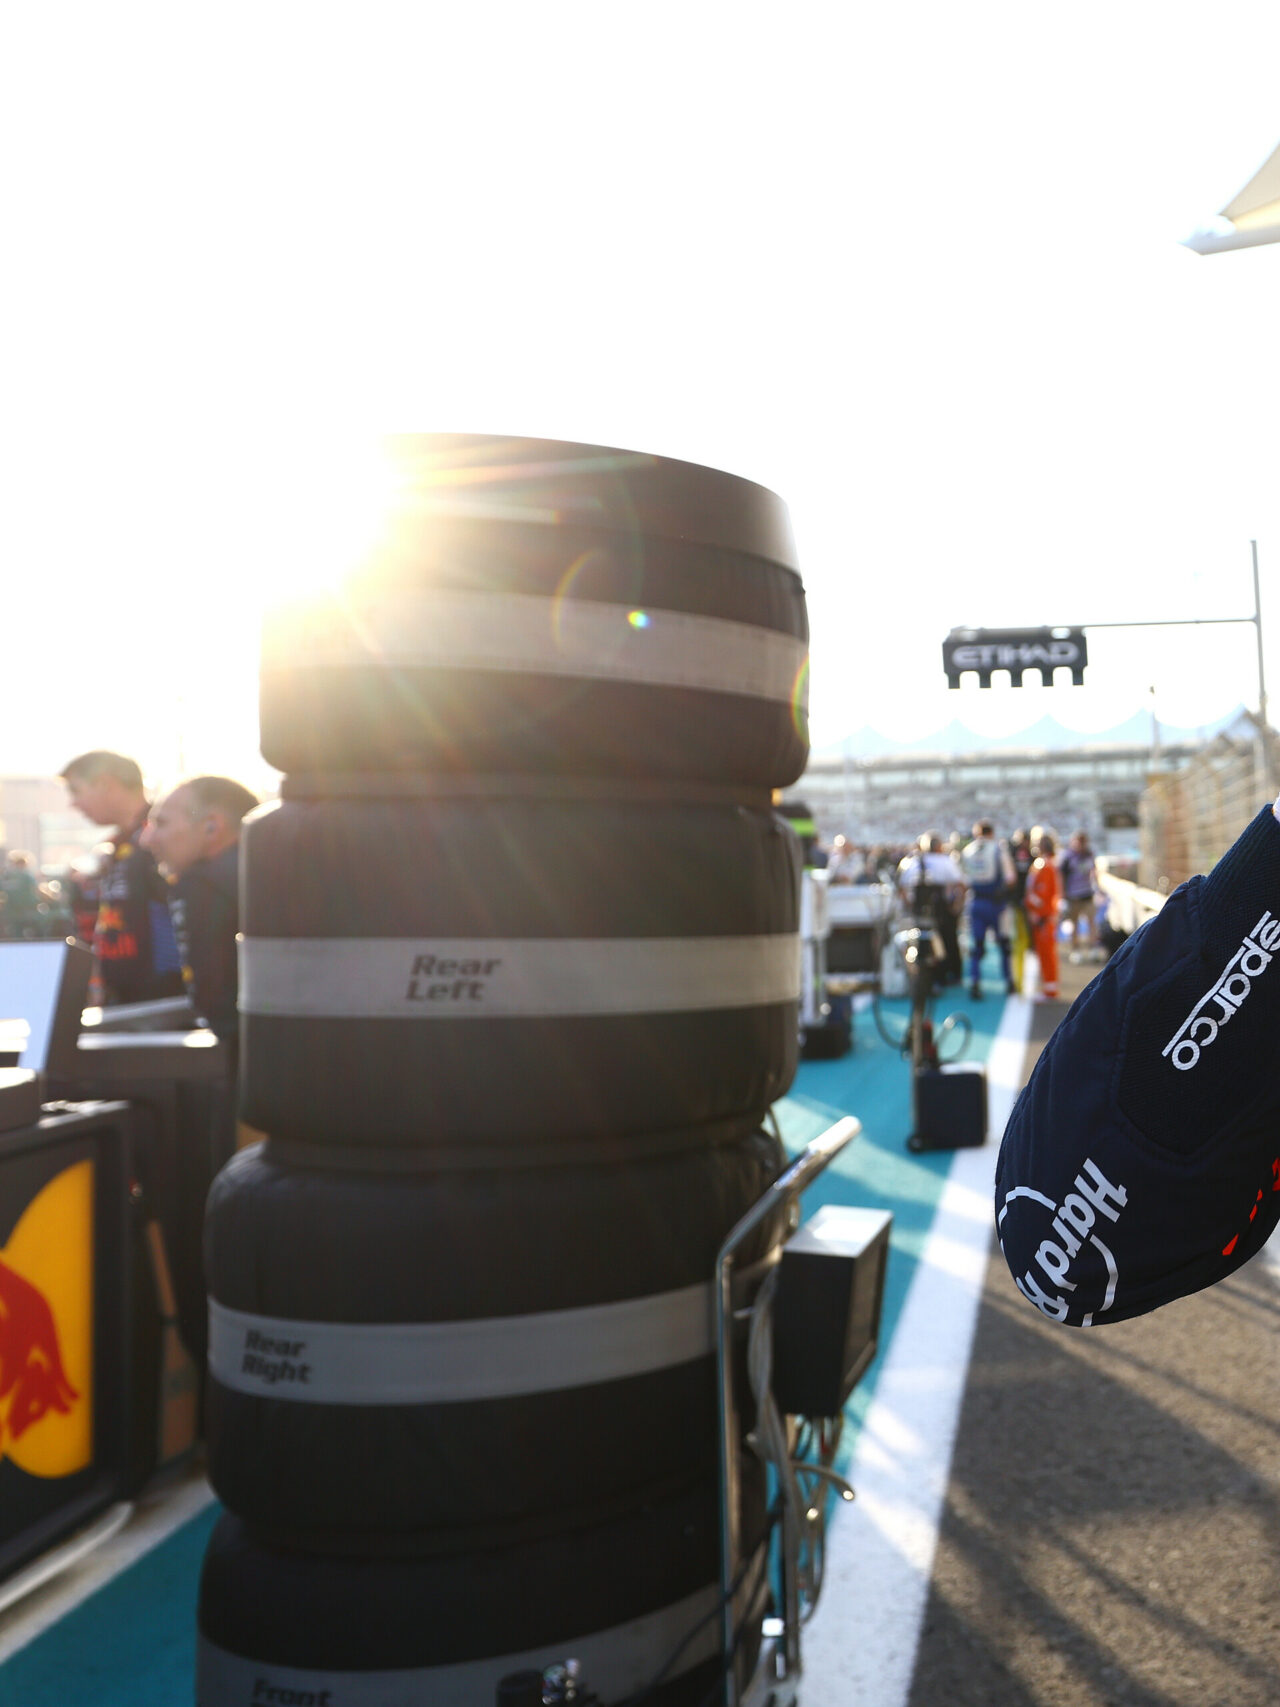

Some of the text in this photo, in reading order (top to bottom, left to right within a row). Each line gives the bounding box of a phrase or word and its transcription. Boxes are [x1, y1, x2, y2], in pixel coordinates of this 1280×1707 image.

[951, 640, 1080, 669] ETIHAD
[411, 954, 503, 977] Rear
[406, 979, 485, 1001] Left
[1034, 1157, 1129, 1292] Hard
[244, 1329, 307, 1358] Rear
[241, 1353, 312, 1385] Right
[252, 1678, 332, 1706] Front
